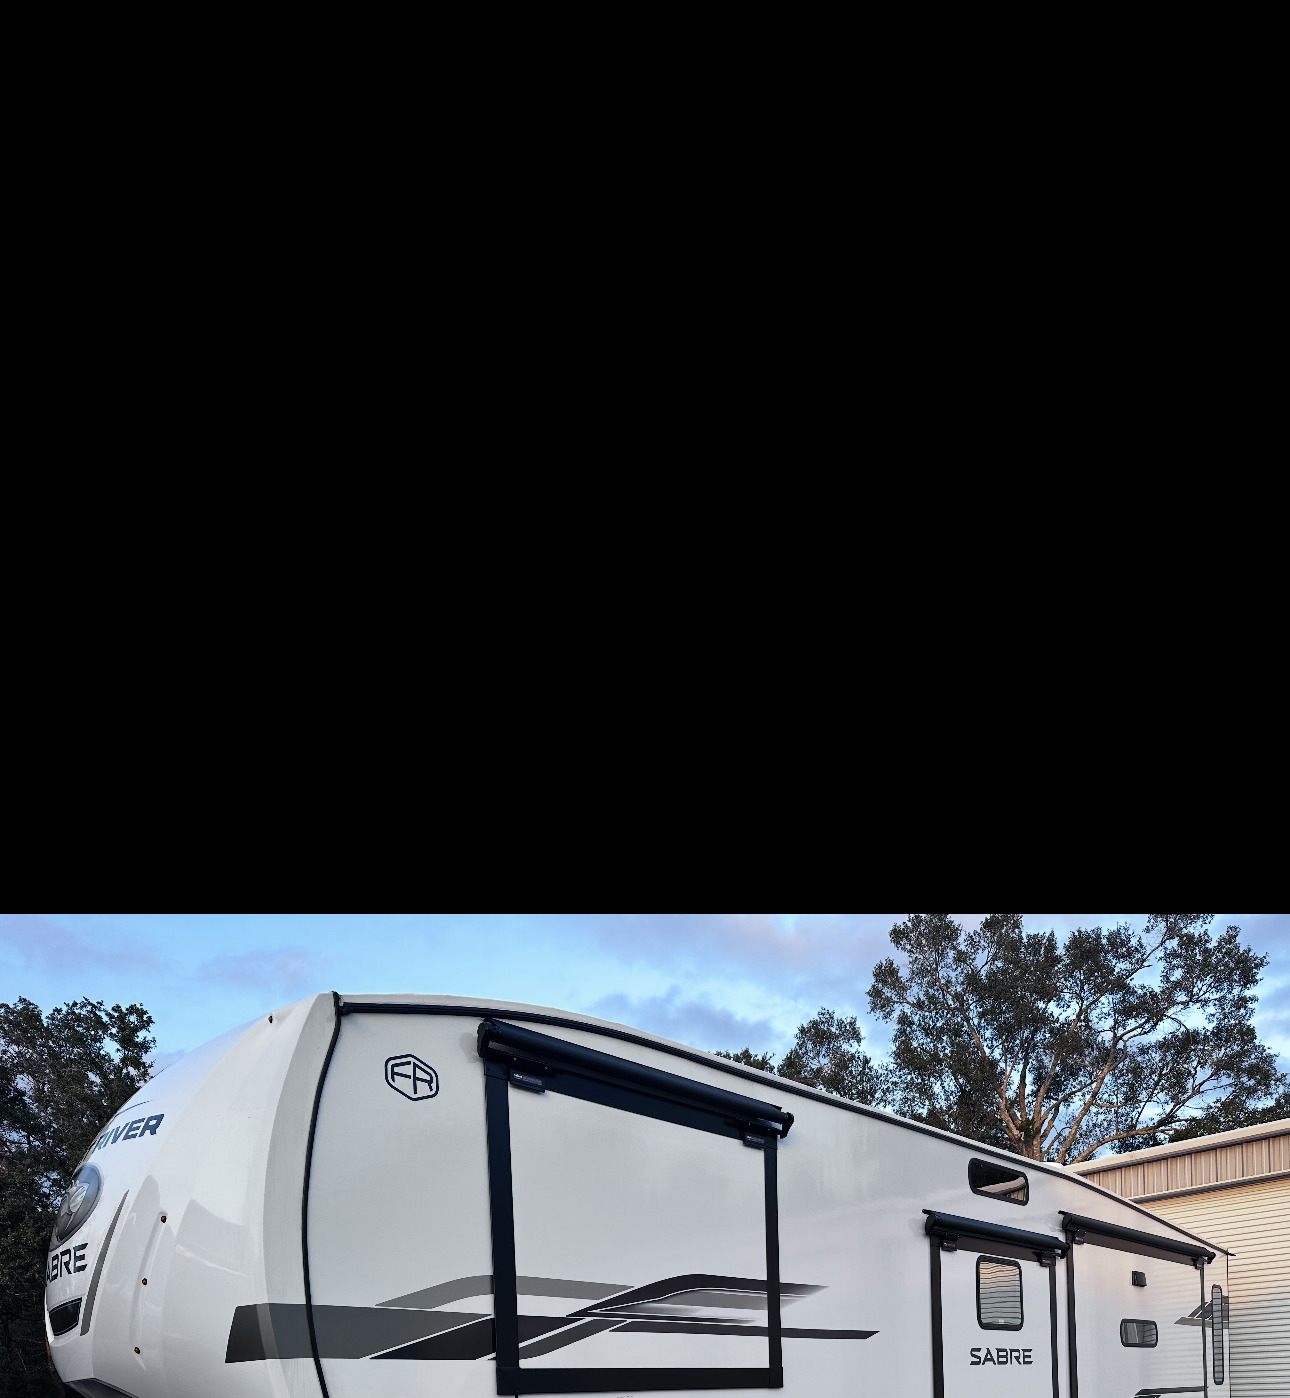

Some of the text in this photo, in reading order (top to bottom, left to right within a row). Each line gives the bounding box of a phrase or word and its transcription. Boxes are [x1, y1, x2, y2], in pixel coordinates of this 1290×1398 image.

[390, 1060, 434, 1095] FR
[46, 1242, 89, 1283] ABRE
[969, 1347, 1034, 1366] SABRE
